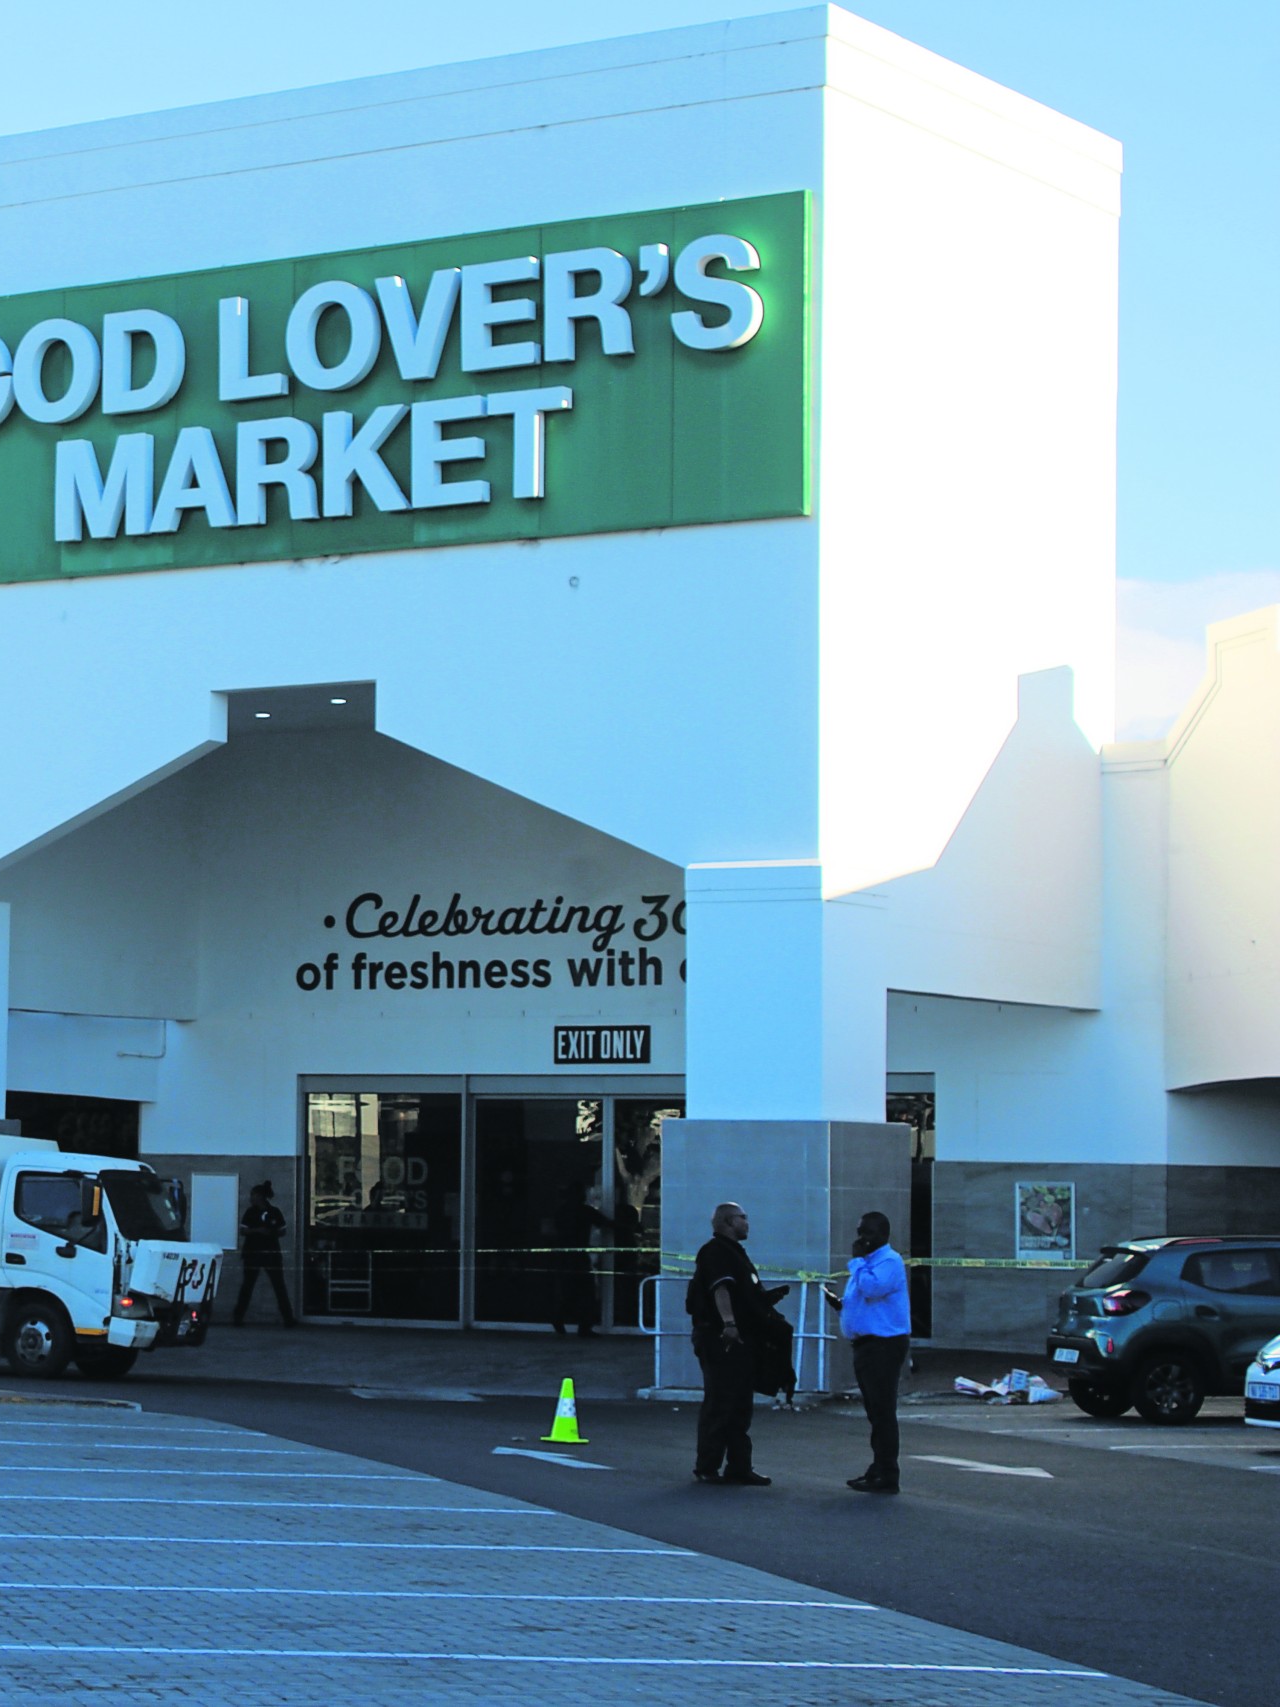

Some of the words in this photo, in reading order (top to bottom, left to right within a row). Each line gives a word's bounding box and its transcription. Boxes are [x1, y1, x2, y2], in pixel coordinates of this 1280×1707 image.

[218, 233, 766, 404] LOVER'S
[55, 386, 573, 543] MARKET
[345, 892, 625, 952] Celebrating
[296, 953, 339, 991] of
[352, 951, 552, 990] freshness
[568, 947, 663, 987] with
[557, 1030, 596, 1060] EXIT
[600, 1029, 645, 1060] ONLY
